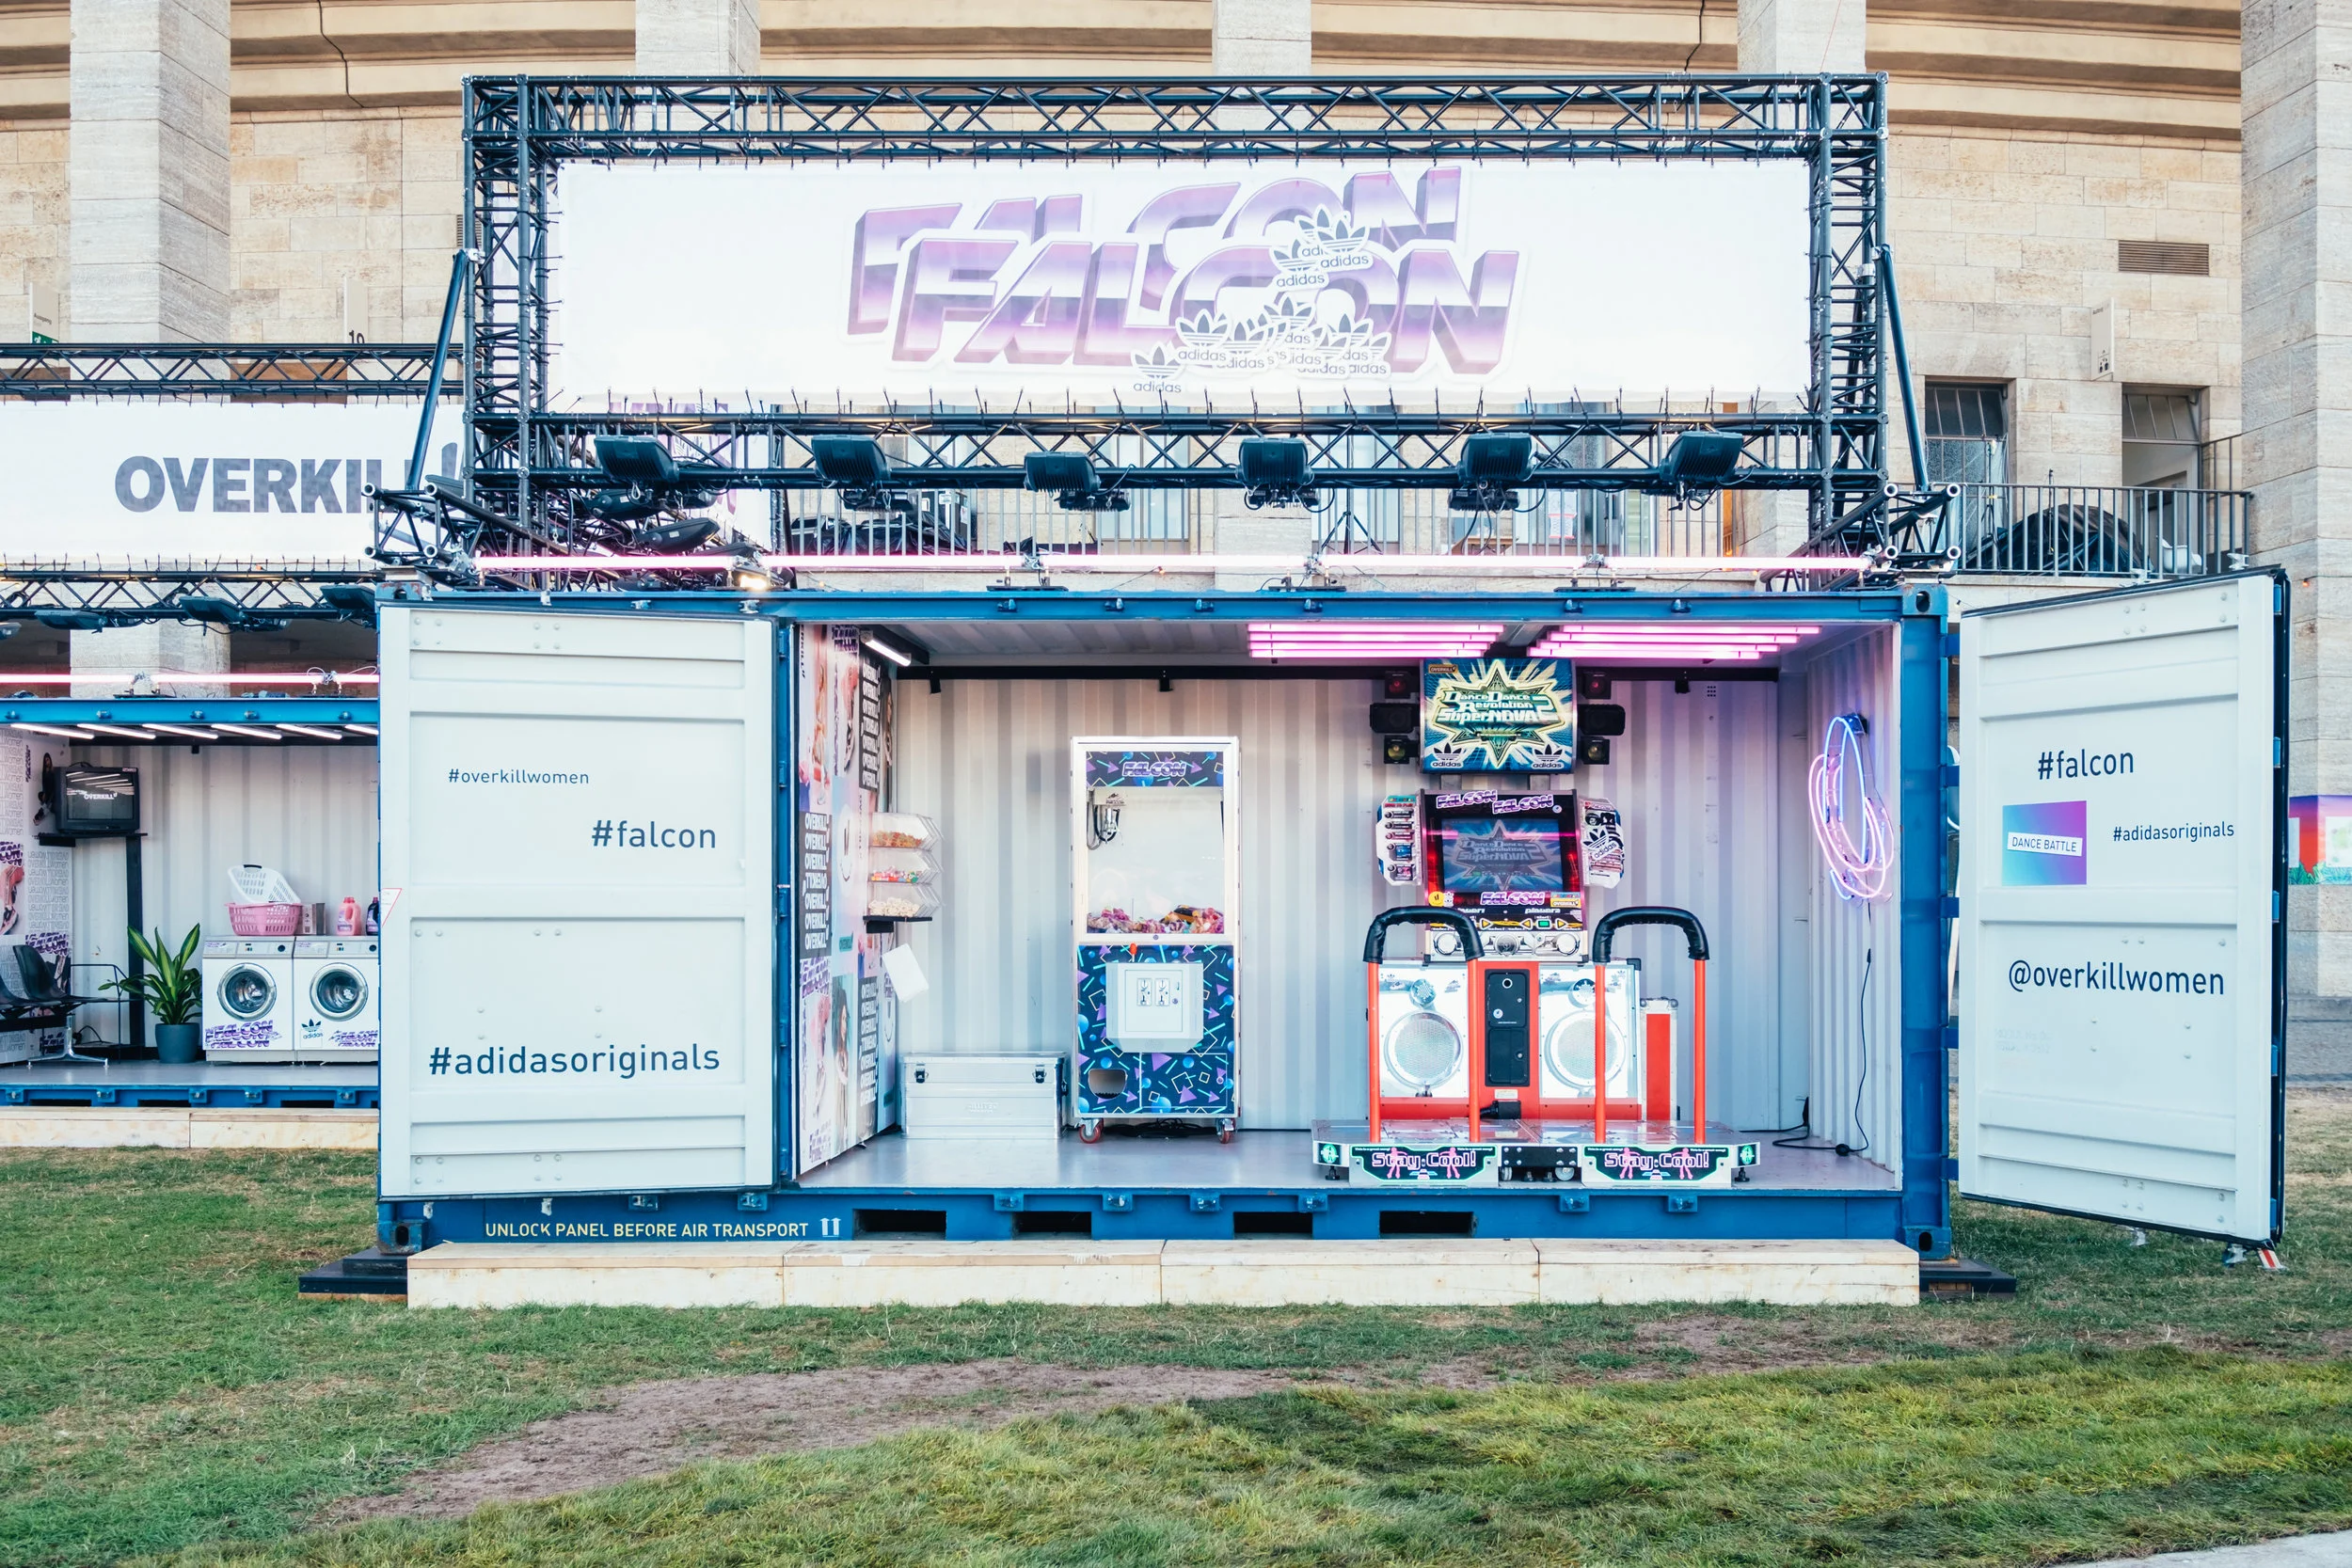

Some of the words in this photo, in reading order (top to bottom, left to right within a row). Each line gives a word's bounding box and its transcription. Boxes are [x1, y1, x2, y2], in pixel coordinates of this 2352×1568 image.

[1320, 255, 1369, 268] adidas
[1277, 274, 1325, 287] adidas
[1178, 350, 1227, 362] adidas
[1219, 357, 1264, 369] didas
[1133, 381, 1182, 393] adidas
[115, 455, 420, 514] OVERKIL
[1532, 695, 1560, 721] 2
[1123, 762, 1186, 777] FALCON
[2037, 748, 2134, 781] #falcon
[448, 768, 589, 784] #overkillwomen
[1438, 790, 1497, 808] FALCON
[1493, 795, 1553, 814] FALCON
[591, 819, 716, 849] #falcon
[2113, 821, 2234, 843] #adidasoriginals
[1595, 842, 1617, 859] adidas
[2012, 836, 2042, 849] DANCE
[2043, 840, 2077, 852] BATTLE
[1481, 892, 1545, 905] FALCON
[2008, 959, 2224, 995] @overkillwomen
[429, 1043, 720, 1079] #adidasoriginals
[1372, 1152, 1421, 1170] Stay
[1426, 1150, 1476, 1167] Cool!
[1604, 1152, 1653, 1170] Stay
[1659, 1151, 1709, 1168] Cool!
[485, 1223, 551, 1237] UNLOCK
[556, 1223, 609, 1237] PANEL
[613, 1223, 677, 1237] BEFORE
[681, 1223, 707, 1237] AIR
[712, 1223, 809, 1237] TRANSPORT
